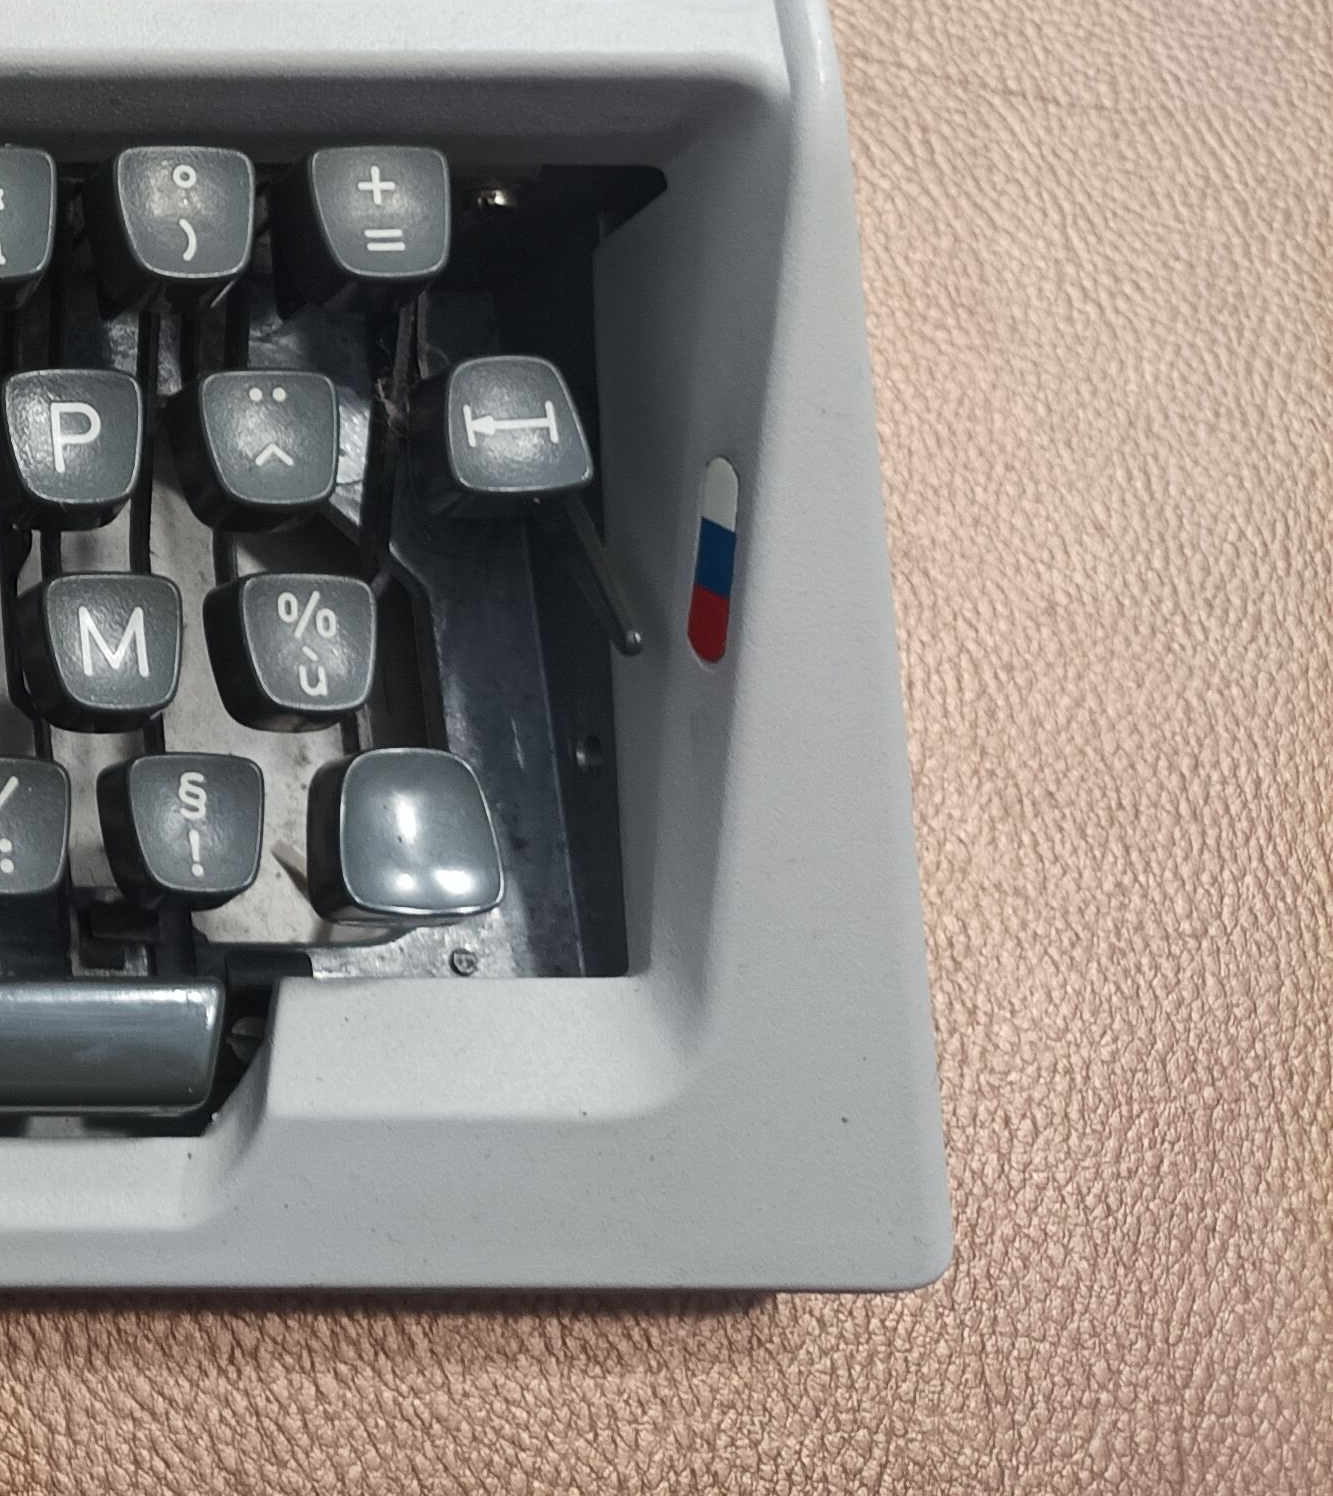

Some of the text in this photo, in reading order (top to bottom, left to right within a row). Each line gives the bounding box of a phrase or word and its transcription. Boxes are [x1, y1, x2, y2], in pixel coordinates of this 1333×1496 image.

[357, 166, 400, 209] +
[364, 228, 406, 251] =
[45, 402, 101, 474] P
[277, 591, 338, 641] %
[78, 606, 149, 677] M
[298, 646, 328, 696] ù
[174, 772, 207, 823] §
[188, 829, 204, 876] !
